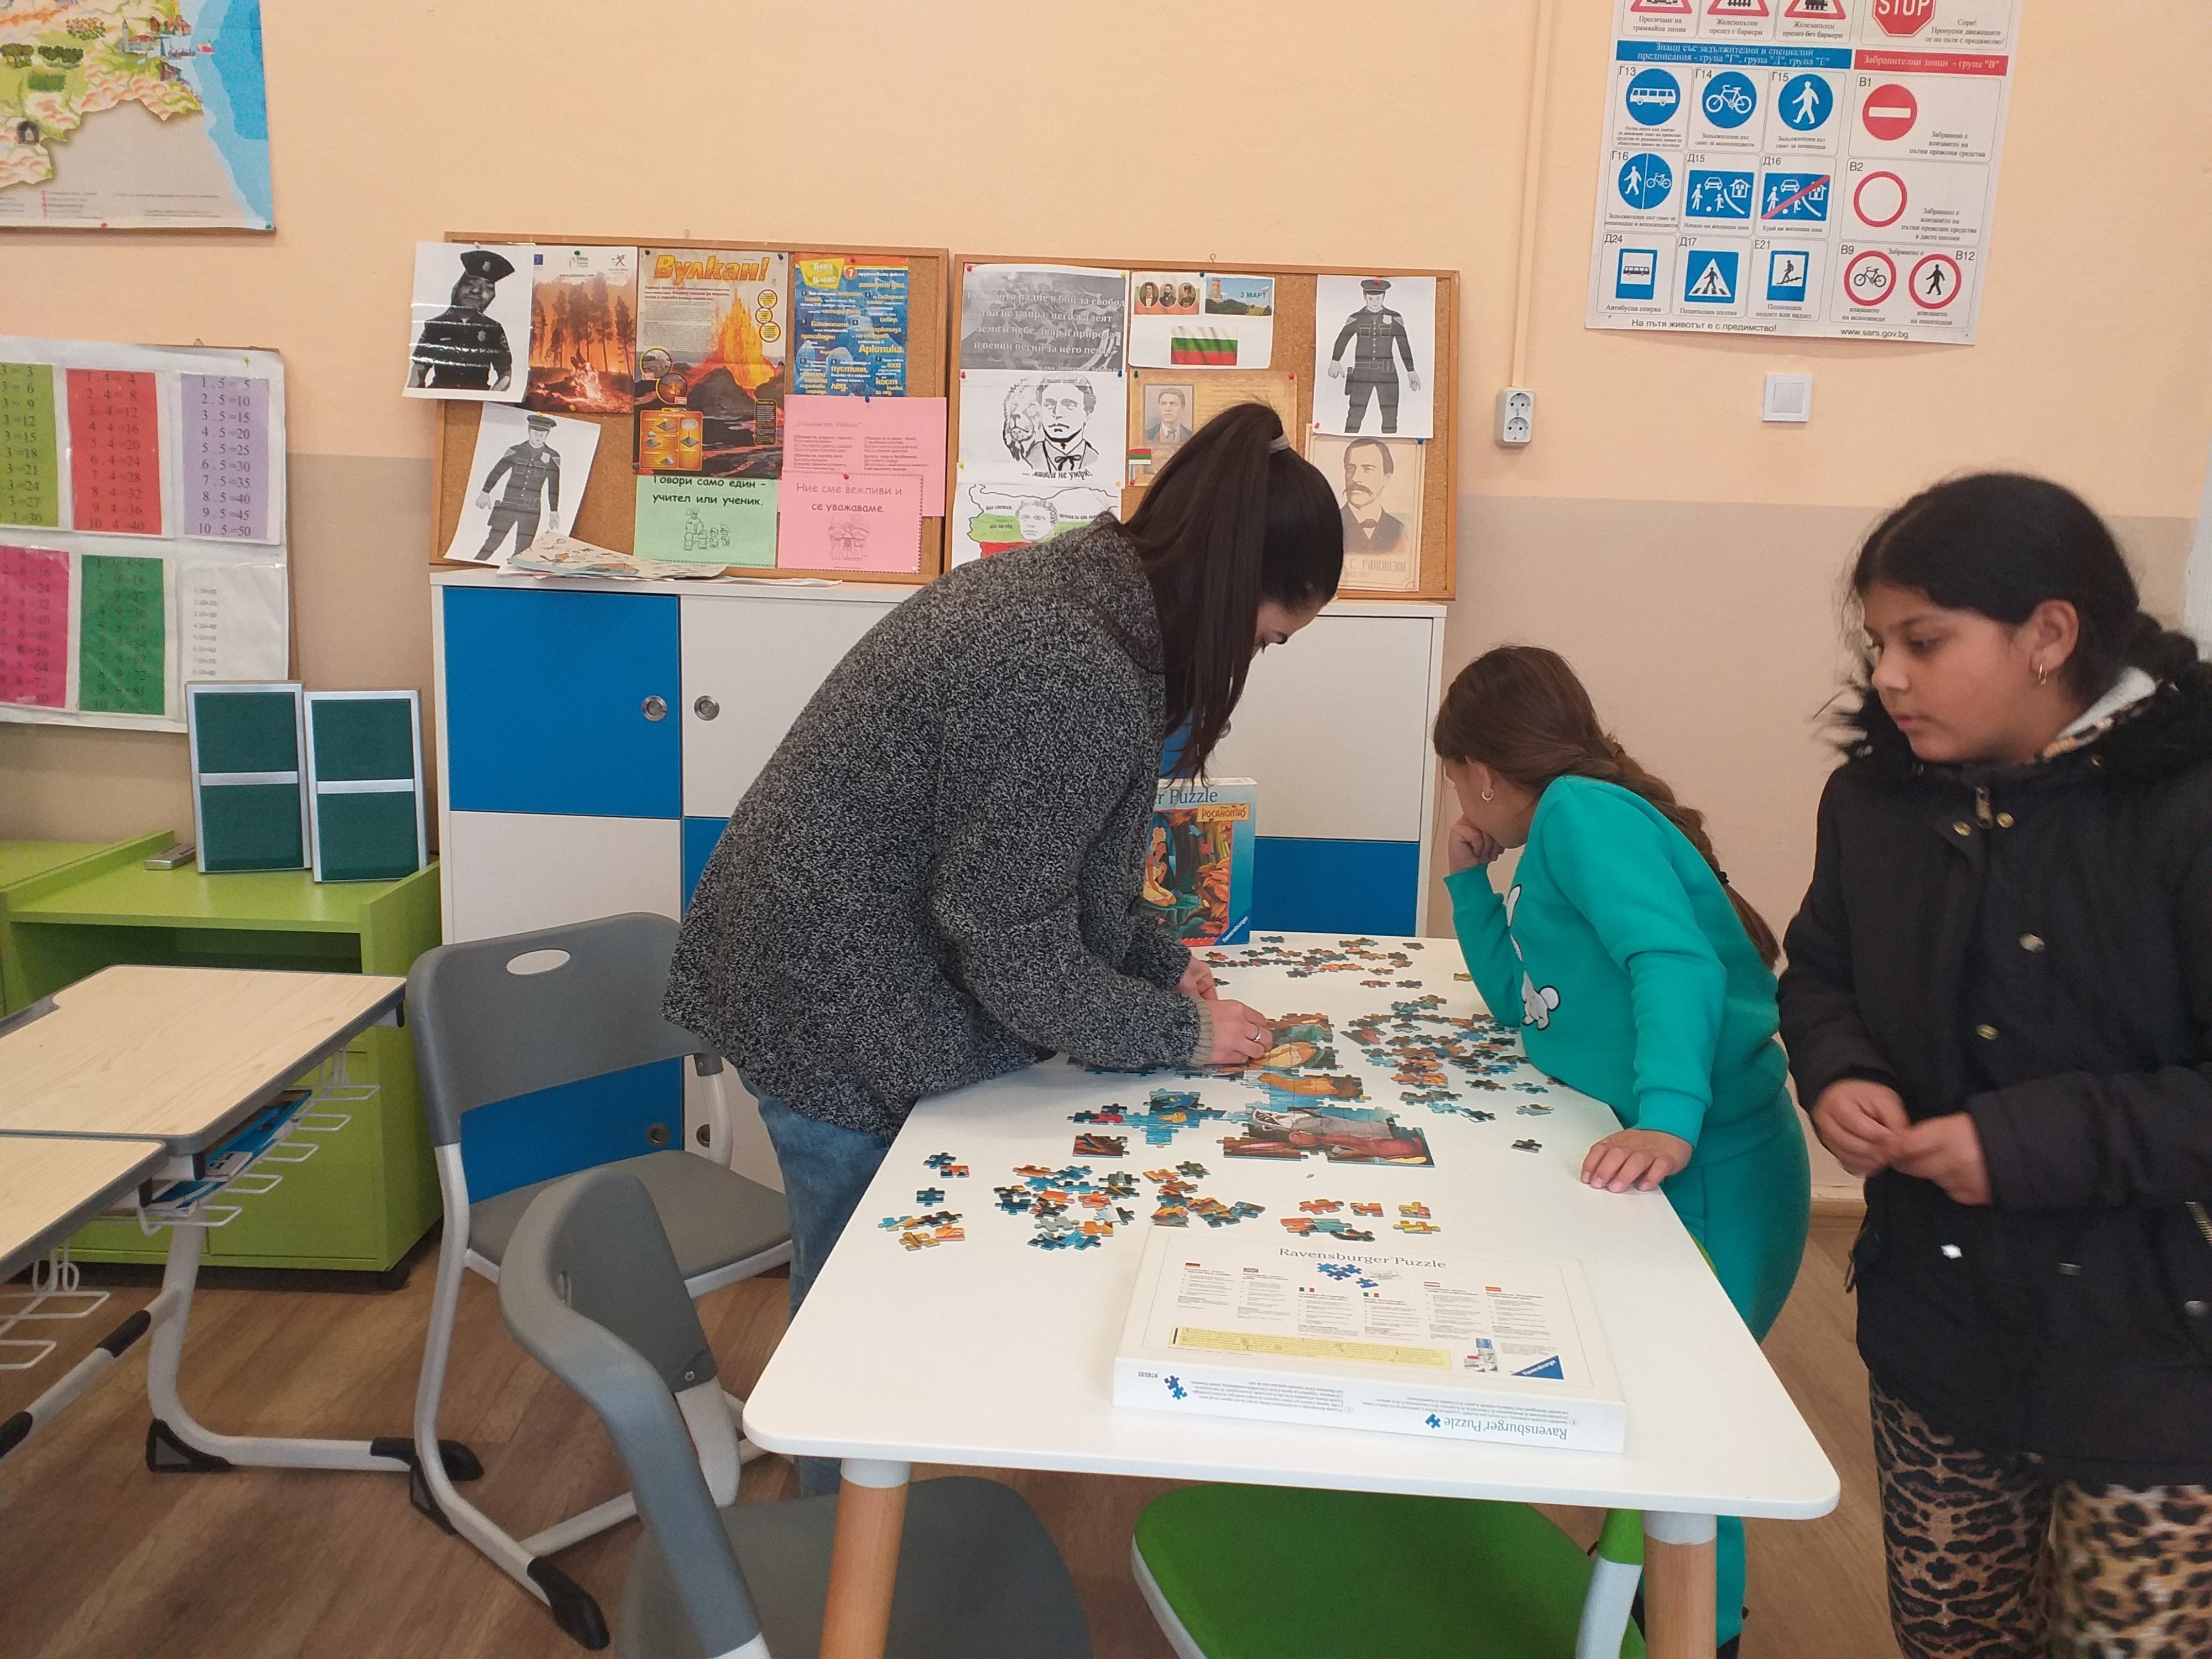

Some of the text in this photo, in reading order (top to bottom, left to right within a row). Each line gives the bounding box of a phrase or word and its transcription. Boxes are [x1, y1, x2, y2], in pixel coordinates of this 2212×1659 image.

[1878, 0, 1929, 15] STOP
[1717, 18, 1757, 27] Железопътен
[1793, 21, 1834, 30] Железопътен
[1656, 43, 1681, 52] Знаци
[1699, 45, 1759, 55] задължителни
[1768, 49, 1813, 58] специални
[1699, 55, 1723, 64] група
[1744, 56, 1767, 65] група
[1789, 58, 1813, 66] група
[1864, 55, 1921, 66] Забранителни
[1959, 60, 1982, 70] група
[1619, 66, 1636, 76] Г13
[1695, 69, 1712, 79] Г14
[1772, 71, 1789, 81] Г15
[1611, 152, 1629, 161] Г16
[1687, 154, 1705, 163] Д15
[1763, 157, 1781, 166] Д16
[1604, 234, 1623, 244] Д24
[1679, 238, 1697, 247] Д17
[1754, 240, 1770, 249] Е21
[653, 254, 770, 285] Вулкан!
[1632, 319, 1644, 327] На
[1646, 320, 1667, 330] пътя
[1669, 320, 1705, 329] животът
[1723, 323, 1777, 332] предимство!
[1840, 328, 1908, 339] www.sars.gov.bg
[697, 478, 724, 488] само
[729, 480, 755, 489] един
[796, 483, 818, 493] Ние
[822, 486, 842, 494] сме
[845, 486, 891, 495] вежливи
[652, 493, 763, 507] учител или ученик.
[811, 503, 885, 514] се уважаваме.
[1170, 788, 1218, 805] Puzzle
[1202, 807, 1246, 820] POCAHONTAS
[1222, 915, 1249, 943] Ravensburger
[1280, 1248, 1447, 1269] Ravensburger Puzzle
[1444, 1417, 1567, 1440] Ravensburger Puzzle
